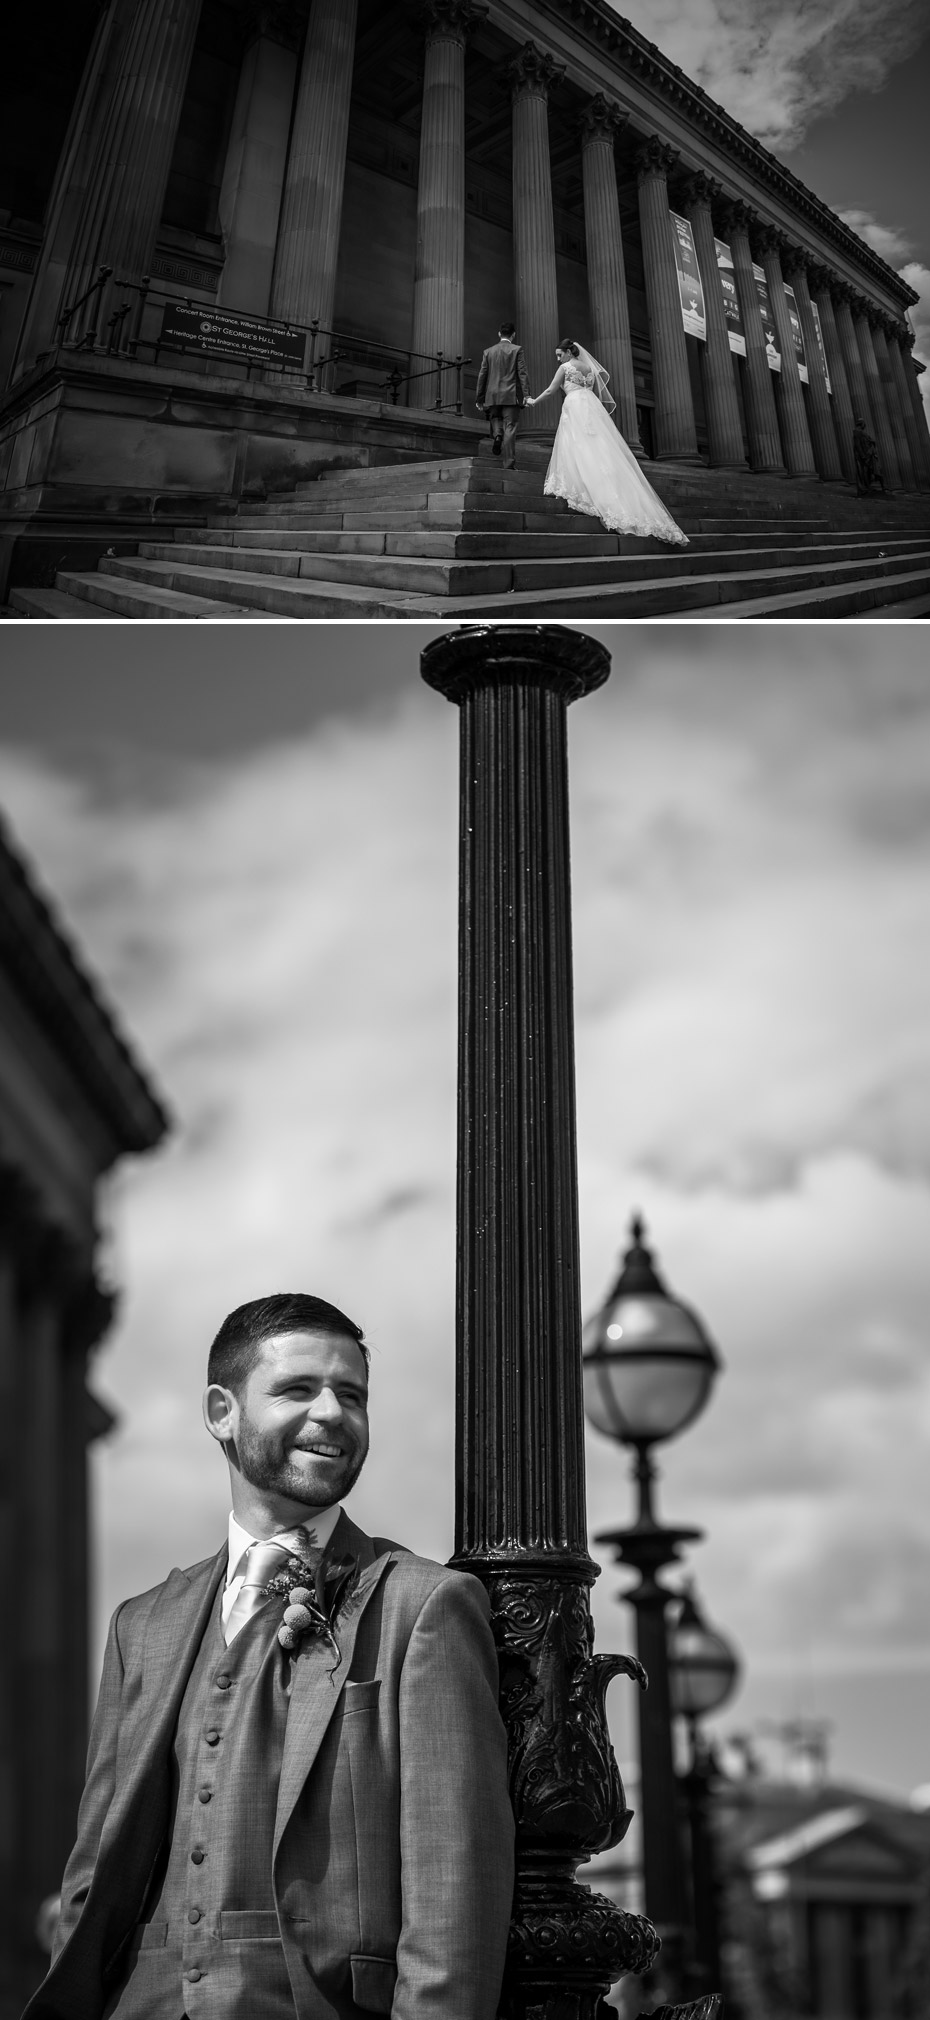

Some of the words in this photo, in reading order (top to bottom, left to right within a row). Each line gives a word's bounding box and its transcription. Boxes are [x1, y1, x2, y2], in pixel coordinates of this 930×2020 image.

[176, 306, 198, 315] Concert
[199, 311, 214, 320] Room
[215, 315, 240, 326] Entrance,
[240, 321, 257, 329] William
[272, 328, 286, 336] Street
[173, 330, 197, 340] Heritage
[198, 334, 216, 343] Centre
[270, 349, 284, 357] Place
[211, 325, 222, 333] ST
[222, 327, 258, 341] GEORGE'S
[258, 335, 276, 345] HALL
